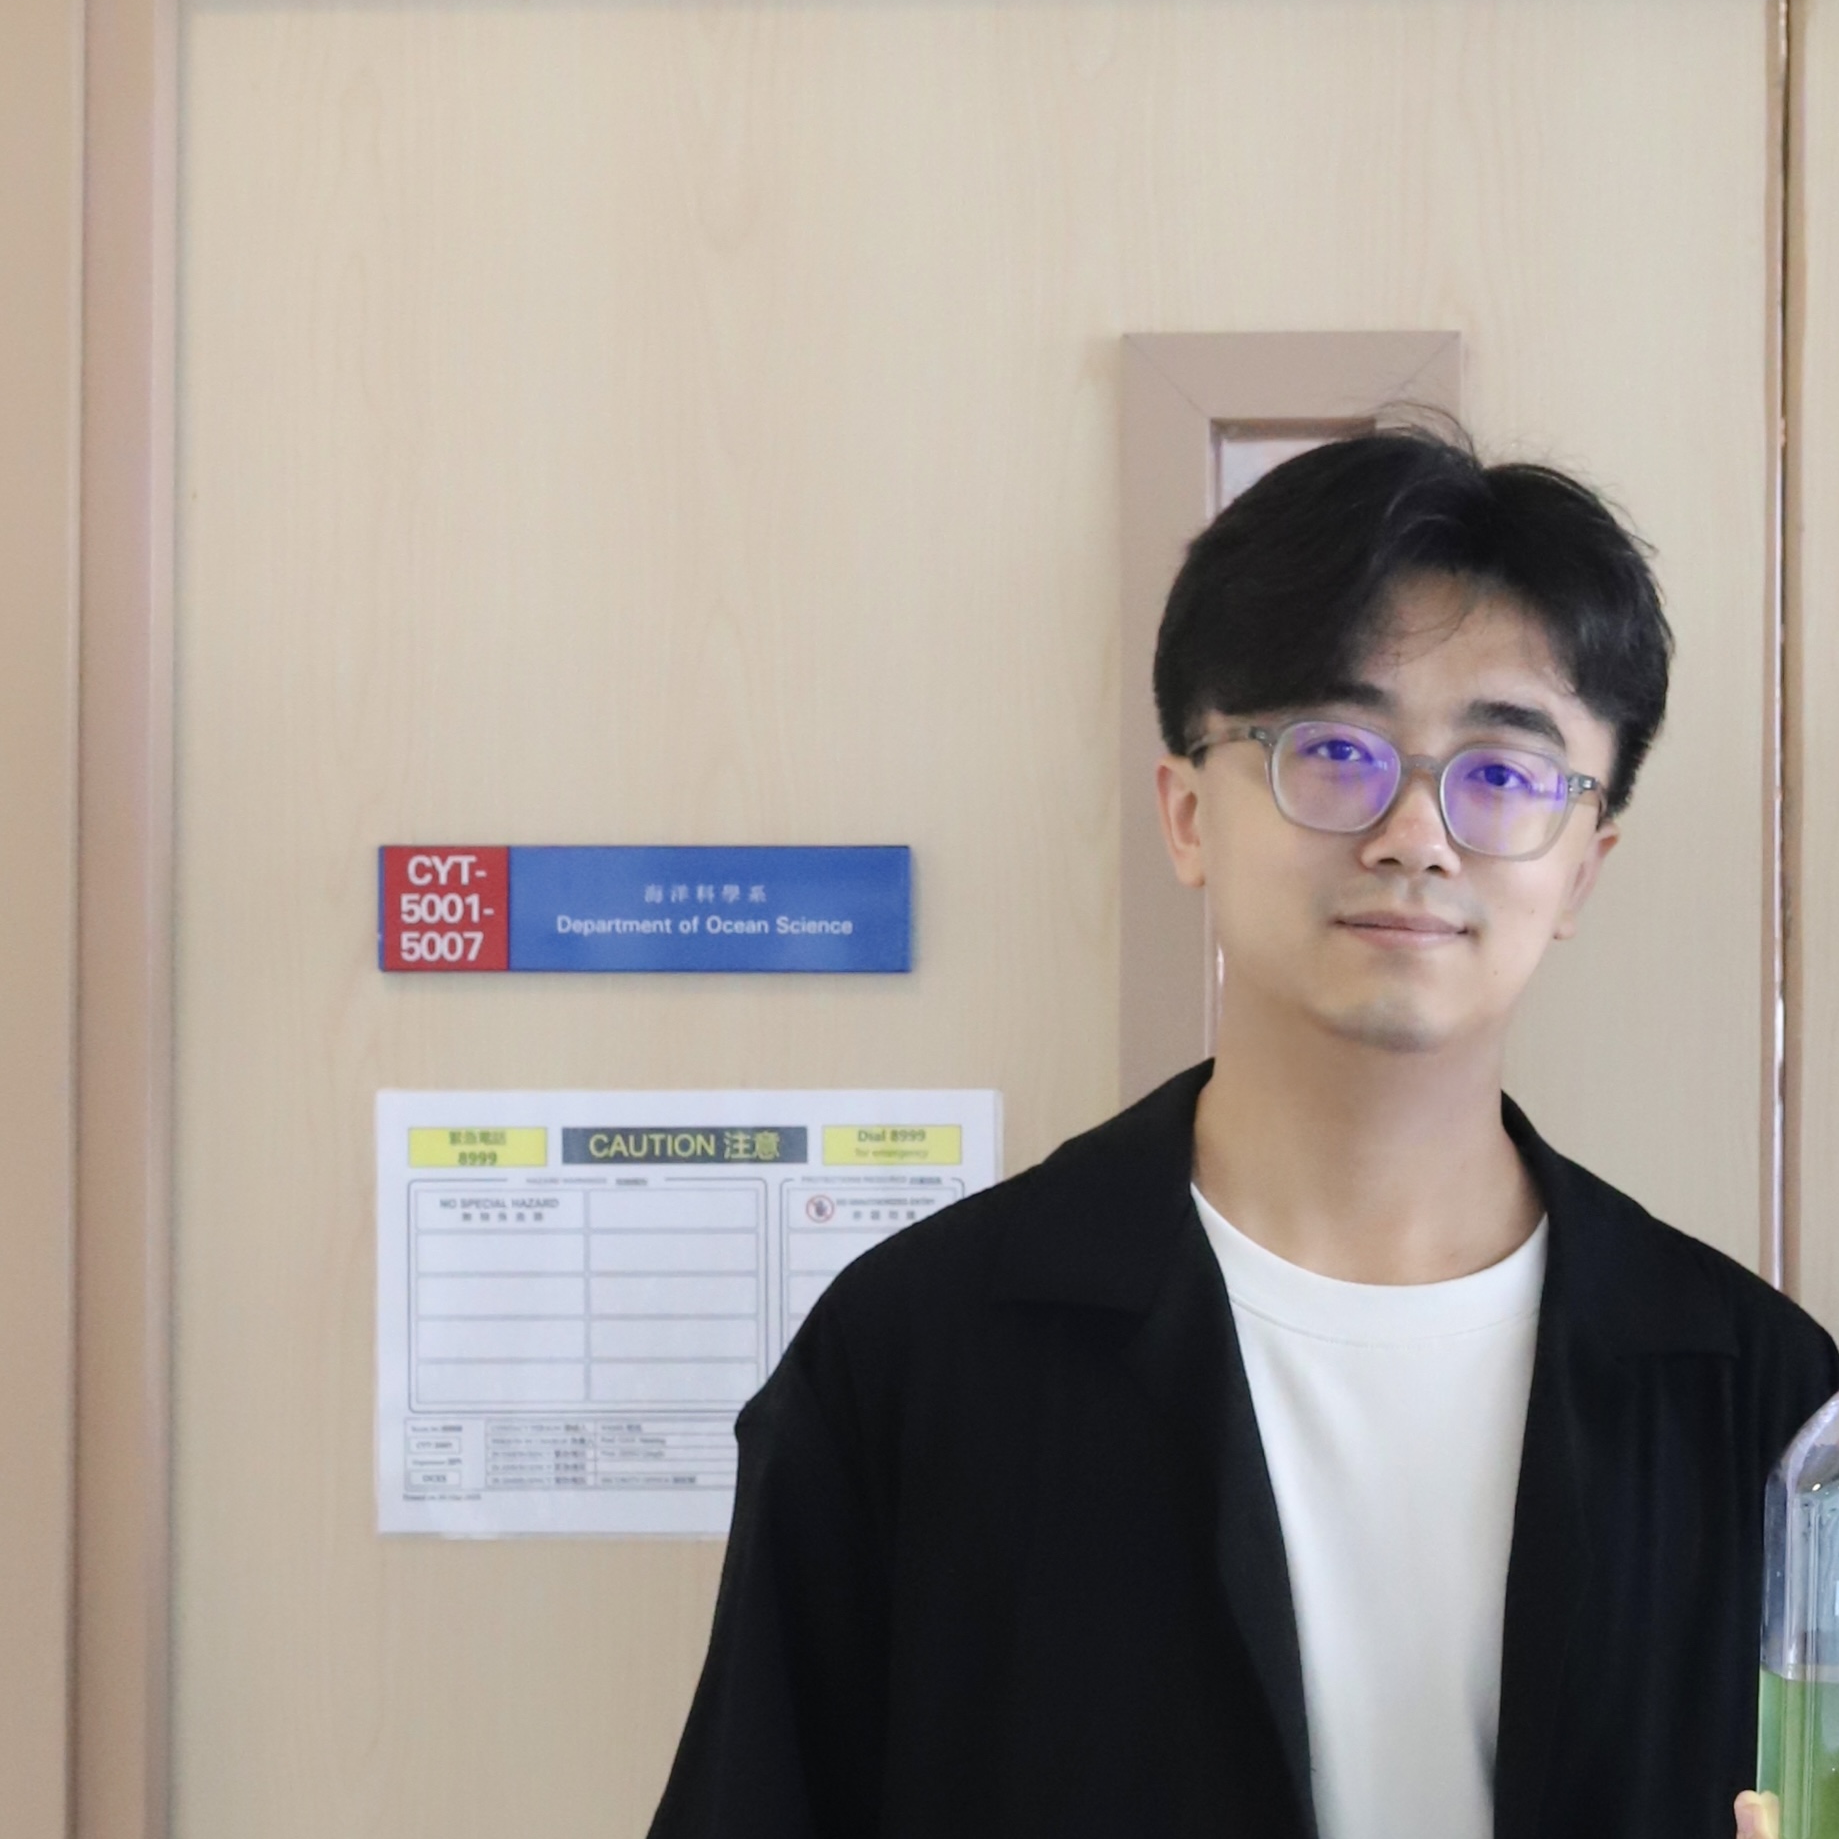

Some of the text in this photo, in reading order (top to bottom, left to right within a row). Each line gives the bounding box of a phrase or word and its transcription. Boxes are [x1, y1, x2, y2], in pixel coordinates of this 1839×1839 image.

[407, 855, 487, 886] CYT-
[644, 884, 767, 904] 海洋科學系
[400, 893, 494, 924] 5001-
[557, 915, 853, 936] Department of Ocean Science
[400, 931, 484, 962] 5007
[589, 1131, 780, 1160] CAUTION 注意
[857, 1128, 927, 1143] Dial 8999
[457, 1151, 498, 1166] 8999
[439, 1198, 559, 1209] NO SPECIAL HAZARD
